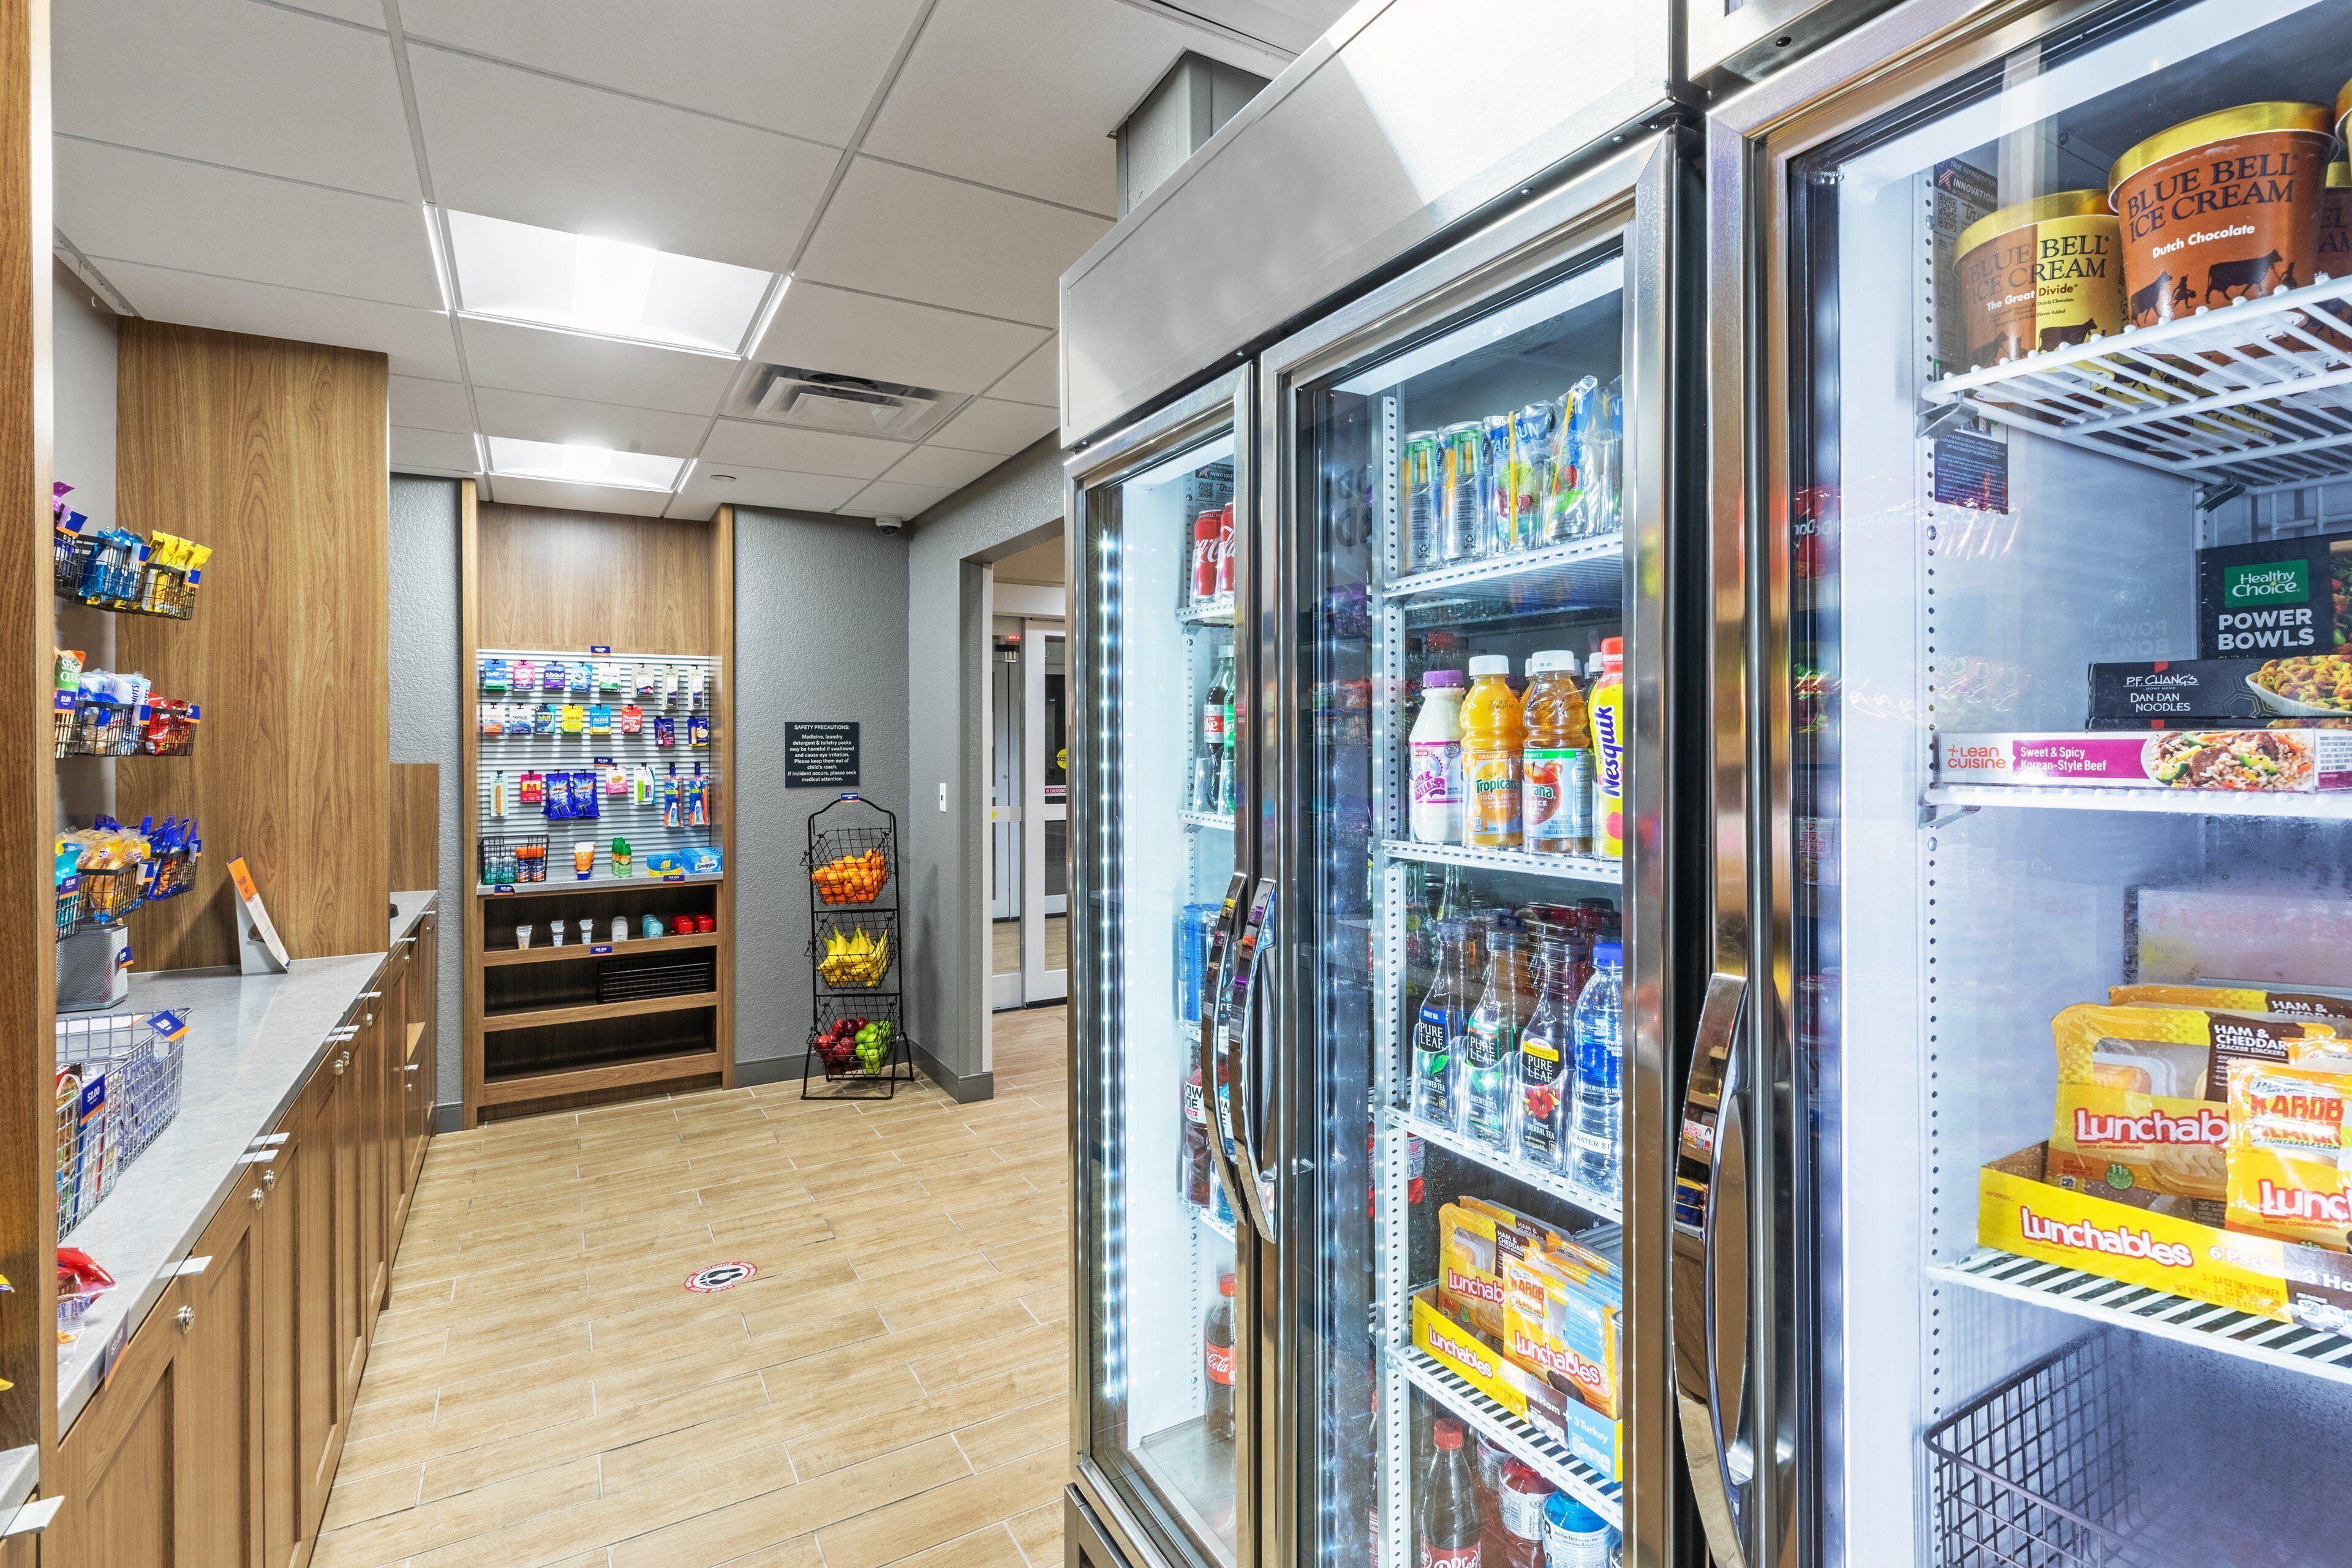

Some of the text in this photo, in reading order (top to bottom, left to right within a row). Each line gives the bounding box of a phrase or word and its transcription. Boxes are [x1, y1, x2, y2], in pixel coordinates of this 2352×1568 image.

[2127, 153, 2297, 221] BLUE BELL
[2129, 179, 2295, 244] ICE CREAM
[2152, 224, 2256, 258] Dutch Chocolate
[1967, 243, 2032, 284] BLUE
[2040, 235, 2108, 259] BELL
[1971, 257, 2107, 304] ICE CREAM
[1986, 284, 2074, 311] The Great Divide
[2240, 570, 2295, 584] Healthy
[2232, 581, 2297, 597] Choice
[2218, 608, 2312, 630] POWER
[2218, 628, 2315, 650] BOWLS
[2127, 674, 2198, 687] P.F. CHANG'S
[2130, 693, 2179, 703] DAN DAN
[2136, 703, 2190, 713] NOODLES
[1594, 705, 1623, 798] Nesquik
[2021, 747, 2085, 760] Sweet & Spicy
[2021, 760, 2107, 772] Korean-Style Beef
[1415, 779, 1438, 797] MILK
[1476, 777, 1520, 794] Tropicana
[660, 859, 671, 870] all
[1423, 1009, 1432, 1019] SWEET
[2271, 1000, 2327, 1013] HAM &
[1420, 1022, 1444, 1039] PURE
[2214, 1025, 2269, 1039] HAM &
[1420, 1033, 1444, 1049] LEAF
[1470, 1036, 1495, 1055] PURE
[2215, 1035, 2288, 1050] CHEDDAR
[1470, 1048, 1496, 1066] LEAF
[1526, 1044, 1556, 1057] MANGO HIBISCUS
[2216, 1044, 2286, 1057] CRACKER STACKERS
[1528, 1055, 1553, 1072] PURE
[1528, 1066, 1554, 1083] LEAF
[1421, 1079, 1438, 1090] BREWED
[87, 1086, 100, 1102] $2.00
[1471, 1095, 1498, 1111] BREWED TEA
[1528, 1123, 1555, 1140] HERBAL TEA
[1532, 1118, 1550, 1129] Brewed
[2076, 1109, 2229, 1144] Lunchab
[1577, 1134, 1610, 1150] WATER $1
[1517, 1221, 1531, 1232] HAM
[1497, 1230, 1512, 1241] HAM
[2021, 1205, 2195, 1268] Lunchables
[1498, 1237, 1525, 1254] CHEDDAR
[2208, 1245, 2223, 1260] 6
[695, 1262, 733, 1275] DISTANCE
[2303, 1269, 2318, 1285] 3
[1428, 1323, 1493, 1379] Lunchables
[1515, 1329, 1602, 1386] Lunchables
[1498, 1366, 1504, 1376] 6
[1531, 1390, 1538, 1402] 3
[1539, 1394, 1561, 1415] Ham
[1574, 1416, 1580, 1427] 3
[1580, 1419, 1608, 1445] Turkey
